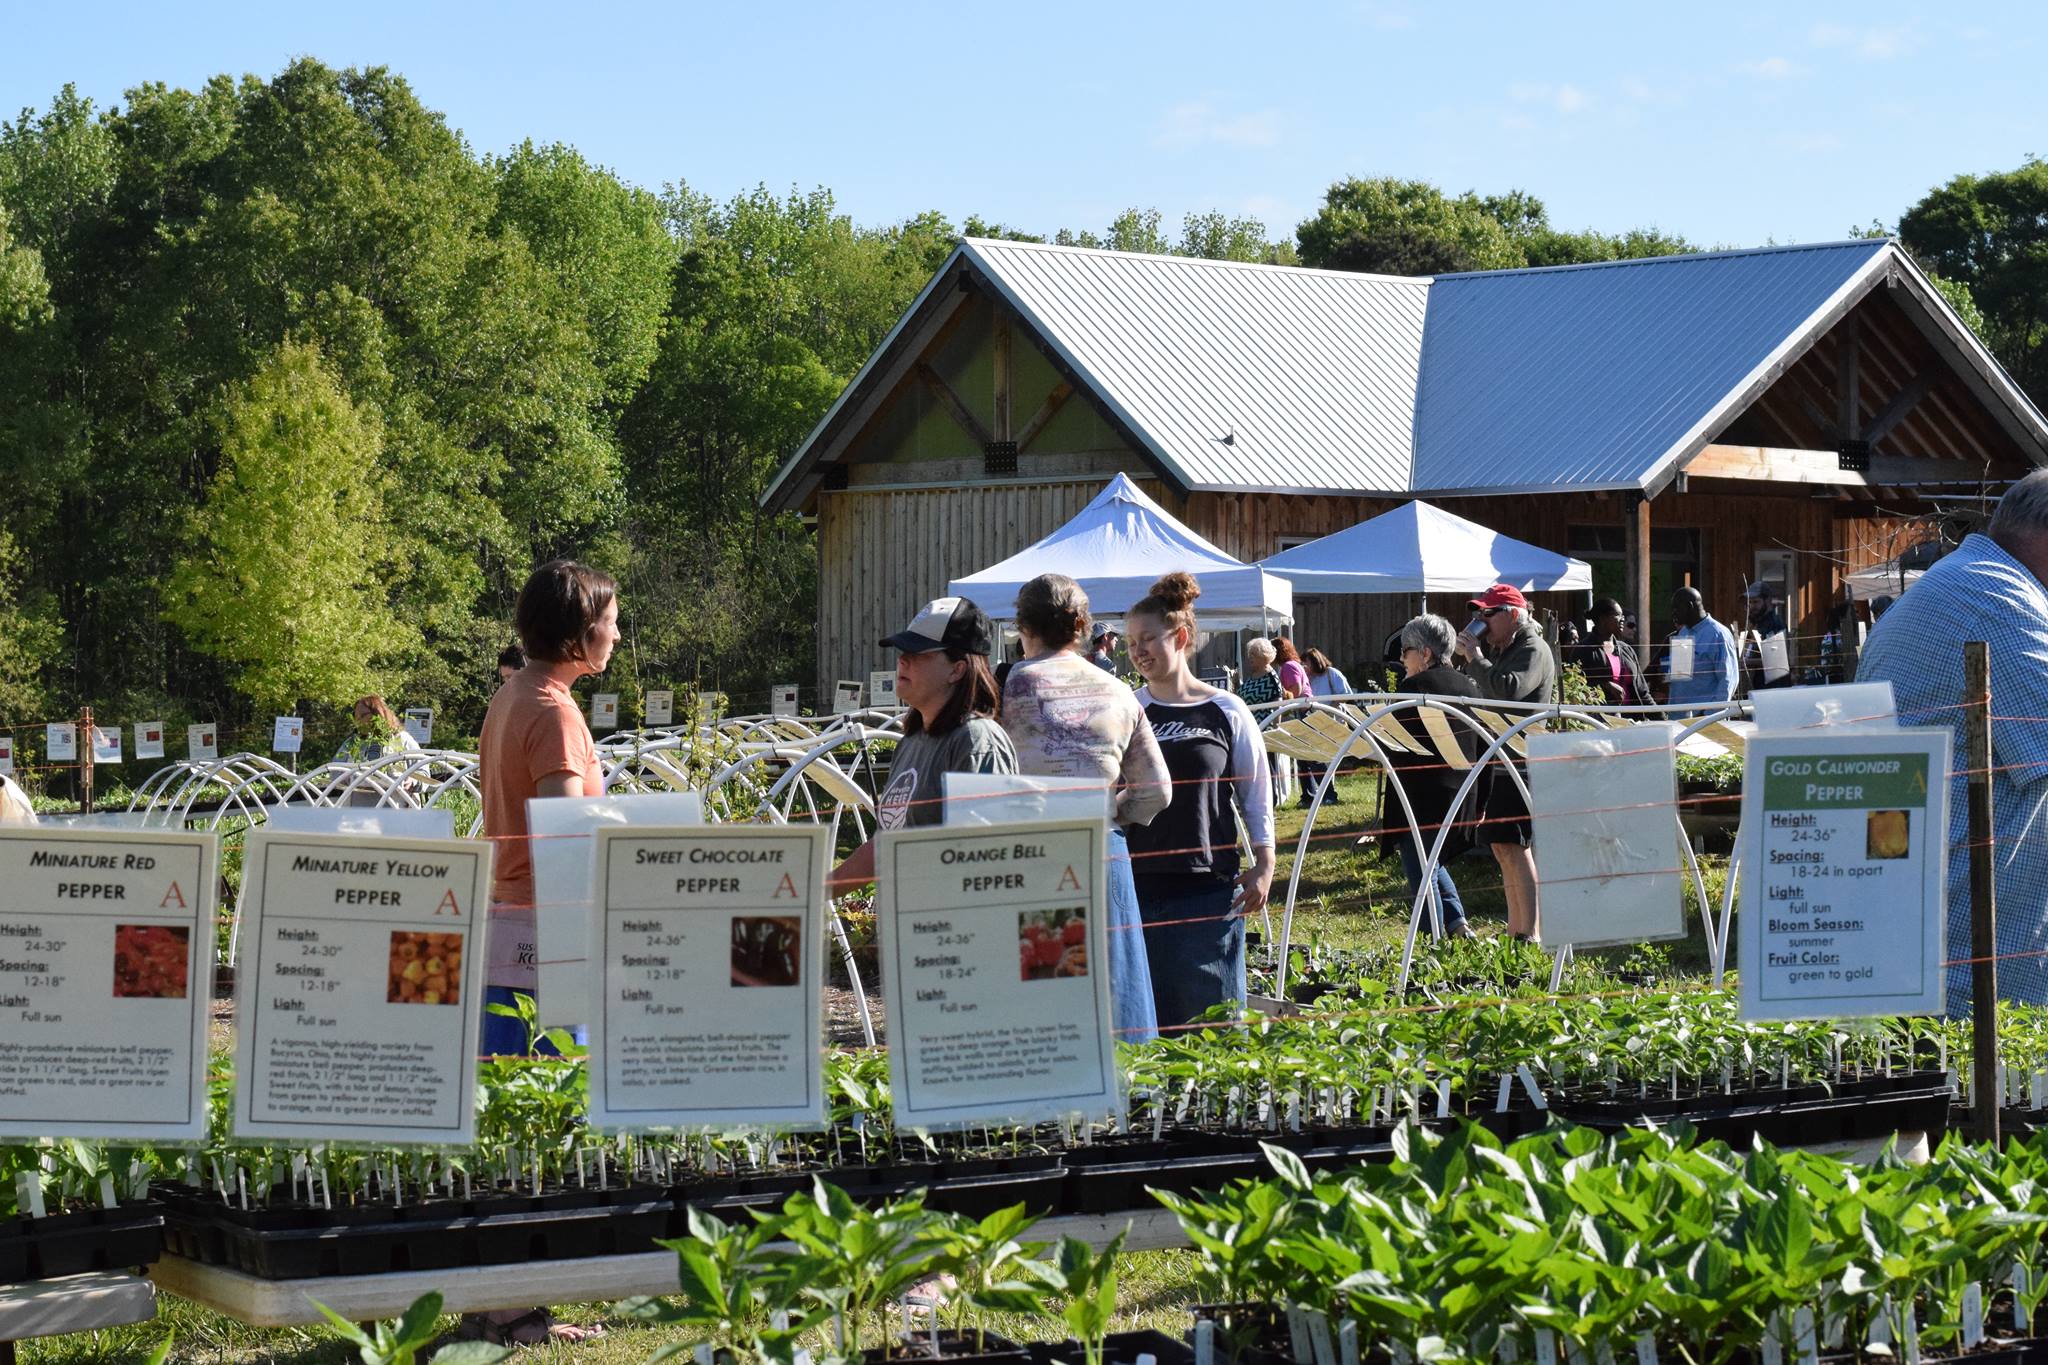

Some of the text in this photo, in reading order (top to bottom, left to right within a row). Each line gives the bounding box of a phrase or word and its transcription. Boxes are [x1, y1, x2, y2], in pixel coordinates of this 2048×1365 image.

[1771, 760, 1901, 776] GOLD CALWONDER
[1805, 784, 1864, 800] PEPPER
[1770, 813, 1816, 827] Height:
[1792, 829, 1836, 842] 24-36"
[30, 851, 155, 870] MINIATURE RED
[636, 848, 784, 864] SWEET CHOCOLATE
[941, 844, 1046, 864] ORANGE BELL
[1769, 849, 1824, 863] Spacing:
[292, 856, 449, 878] MINIATURE YELLOW
[1792, 865, 1883, 879] 18-24 in apart
[963, 874, 1024, 891] PEPPER
[1056, 864, 1081, 891] A
[58, 883, 125, 899] PEPPER
[677, 878, 740, 892] PEPPER
[772, 872, 798, 898] A
[160, 880, 187, 908] A
[335, 889, 401, 906] PEPPER
[1769, 885, 1804, 900] Light:
[434, 889, 461, 915] A
[1790, 902, 1831, 913] full sun
[0, 924, 42, 936] Height:
[623, 920, 662, 932] Height:
[1769, 918, 1864, 932] Bloom Season:
[278, 928, 319, 941] Height:
[647, 935, 686, 946] 24-36"
[25, 941, 67, 951] 24-30"
[1789, 938, 1834, 947] summer
[302, 945, 342, 956] 24-30"
[622, 954, 669, 967] Spacing:
[1769, 952, 1840, 966] Fruit Color:
[276, 963, 324, 976] Spacing:
[647, 969, 685, 980] 12-18"
[1789, 972, 1824, 984] green
[1845, 967, 1873, 982] gold
[25, 976, 66, 987] 12-18"
[301, 980, 340, 992] 12-18"
[622, 988, 653, 1001] Light:
[274, 998, 305, 1011] Light:
[645, 1004, 664, 1015] Full
[21, 1011, 40, 1022] Full
[297, 1015, 315, 1025] Full
